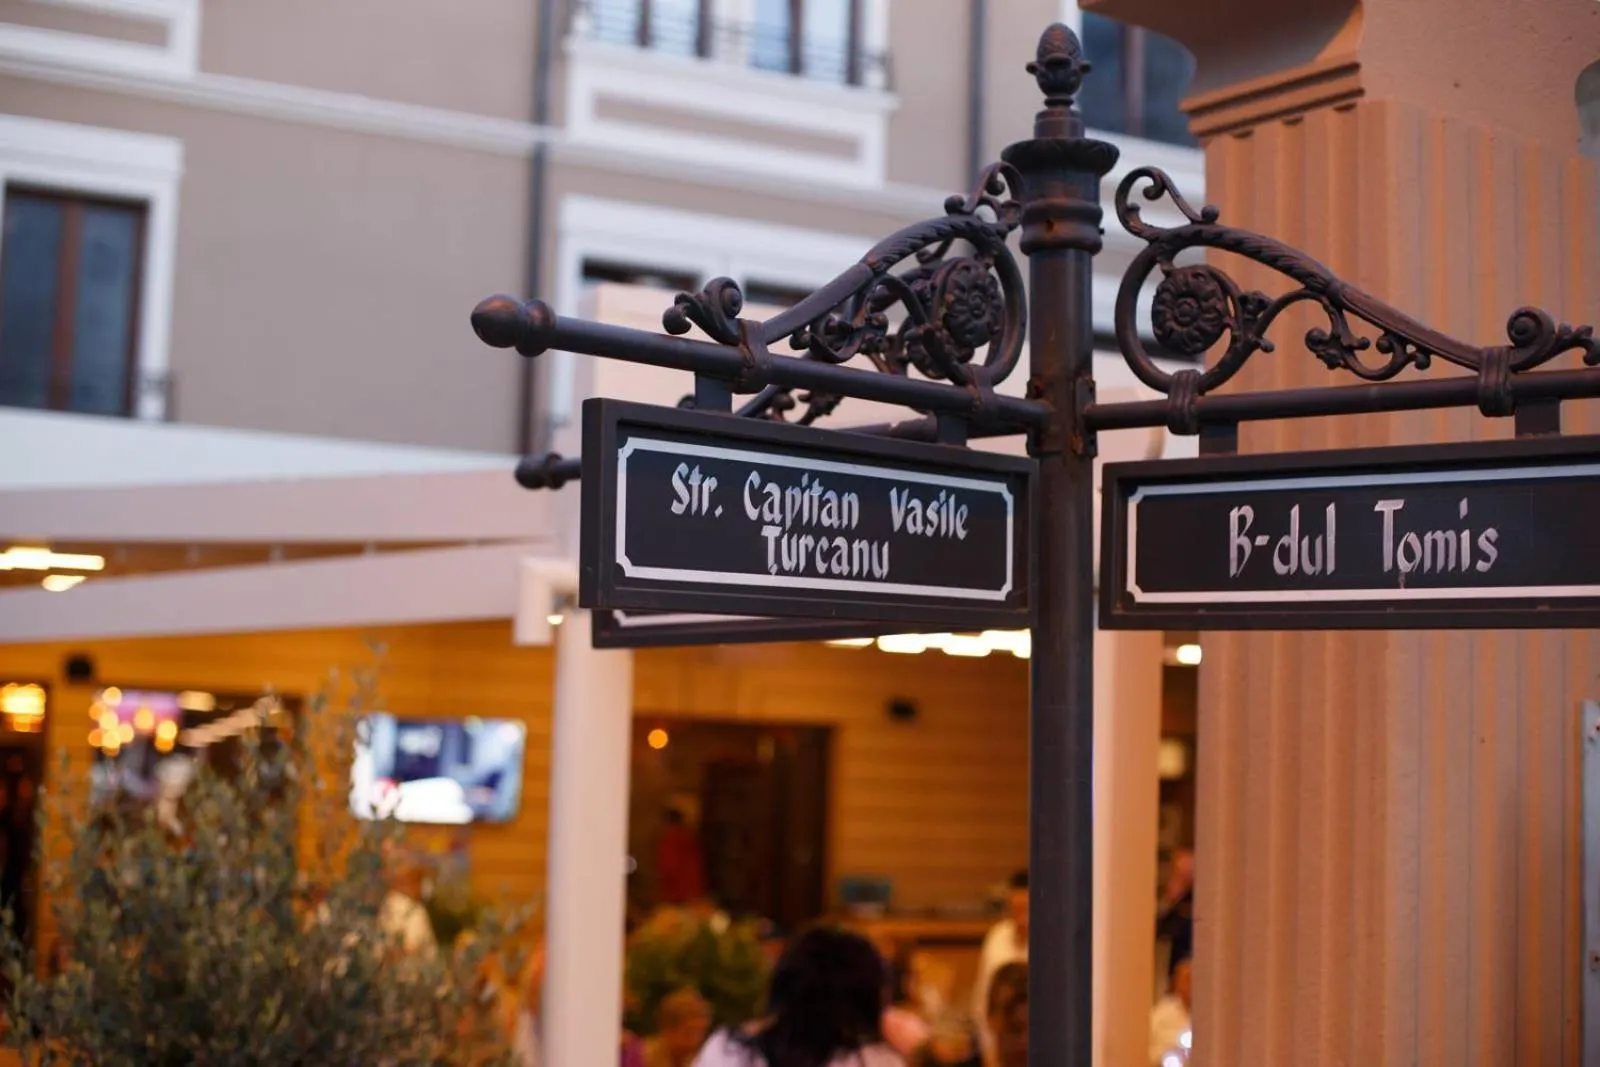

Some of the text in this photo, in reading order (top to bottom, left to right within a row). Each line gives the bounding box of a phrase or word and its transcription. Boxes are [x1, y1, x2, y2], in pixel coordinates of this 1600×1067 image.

[670, 462, 969, 541] Str. Capitan Vasile
[1229, 497, 1500, 578] B-dul Tomis
